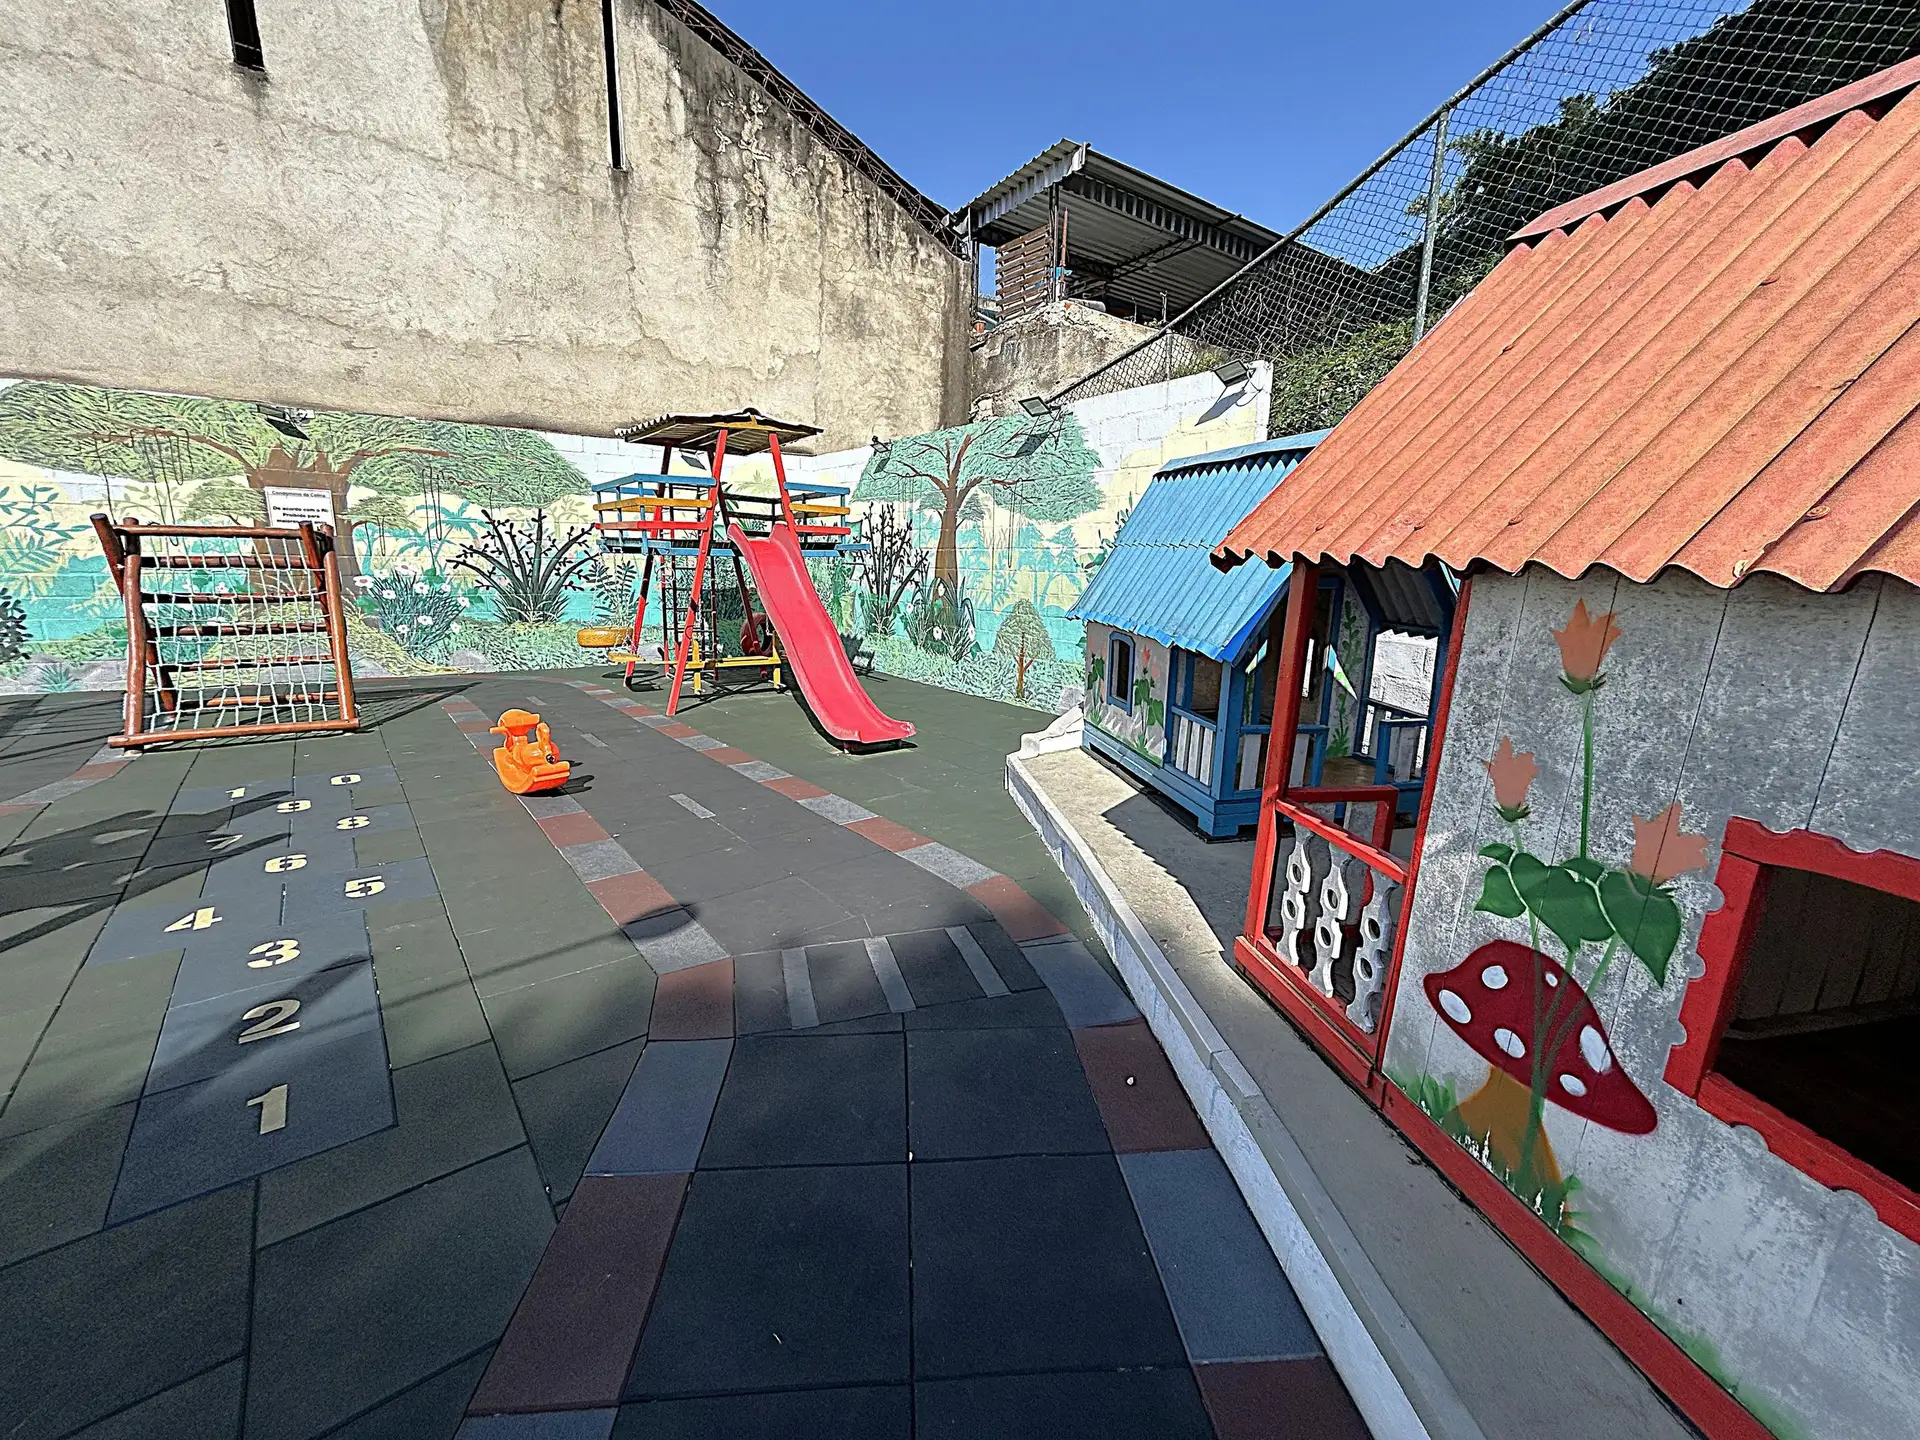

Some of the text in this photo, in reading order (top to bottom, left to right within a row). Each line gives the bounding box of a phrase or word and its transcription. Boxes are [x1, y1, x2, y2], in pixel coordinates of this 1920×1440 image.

[277, 799, 311, 813] 9
[336, 815, 370, 829] 8
[206, 834, 243, 851] 7
[264, 854, 307, 873] 6
[344, 875, 386, 898] 5
[164, 906, 222, 932] 4
[247, 938, 300, 968] 3
[238, 999, 300, 1044] 2
[246, 1083, 289, 1135] 1
